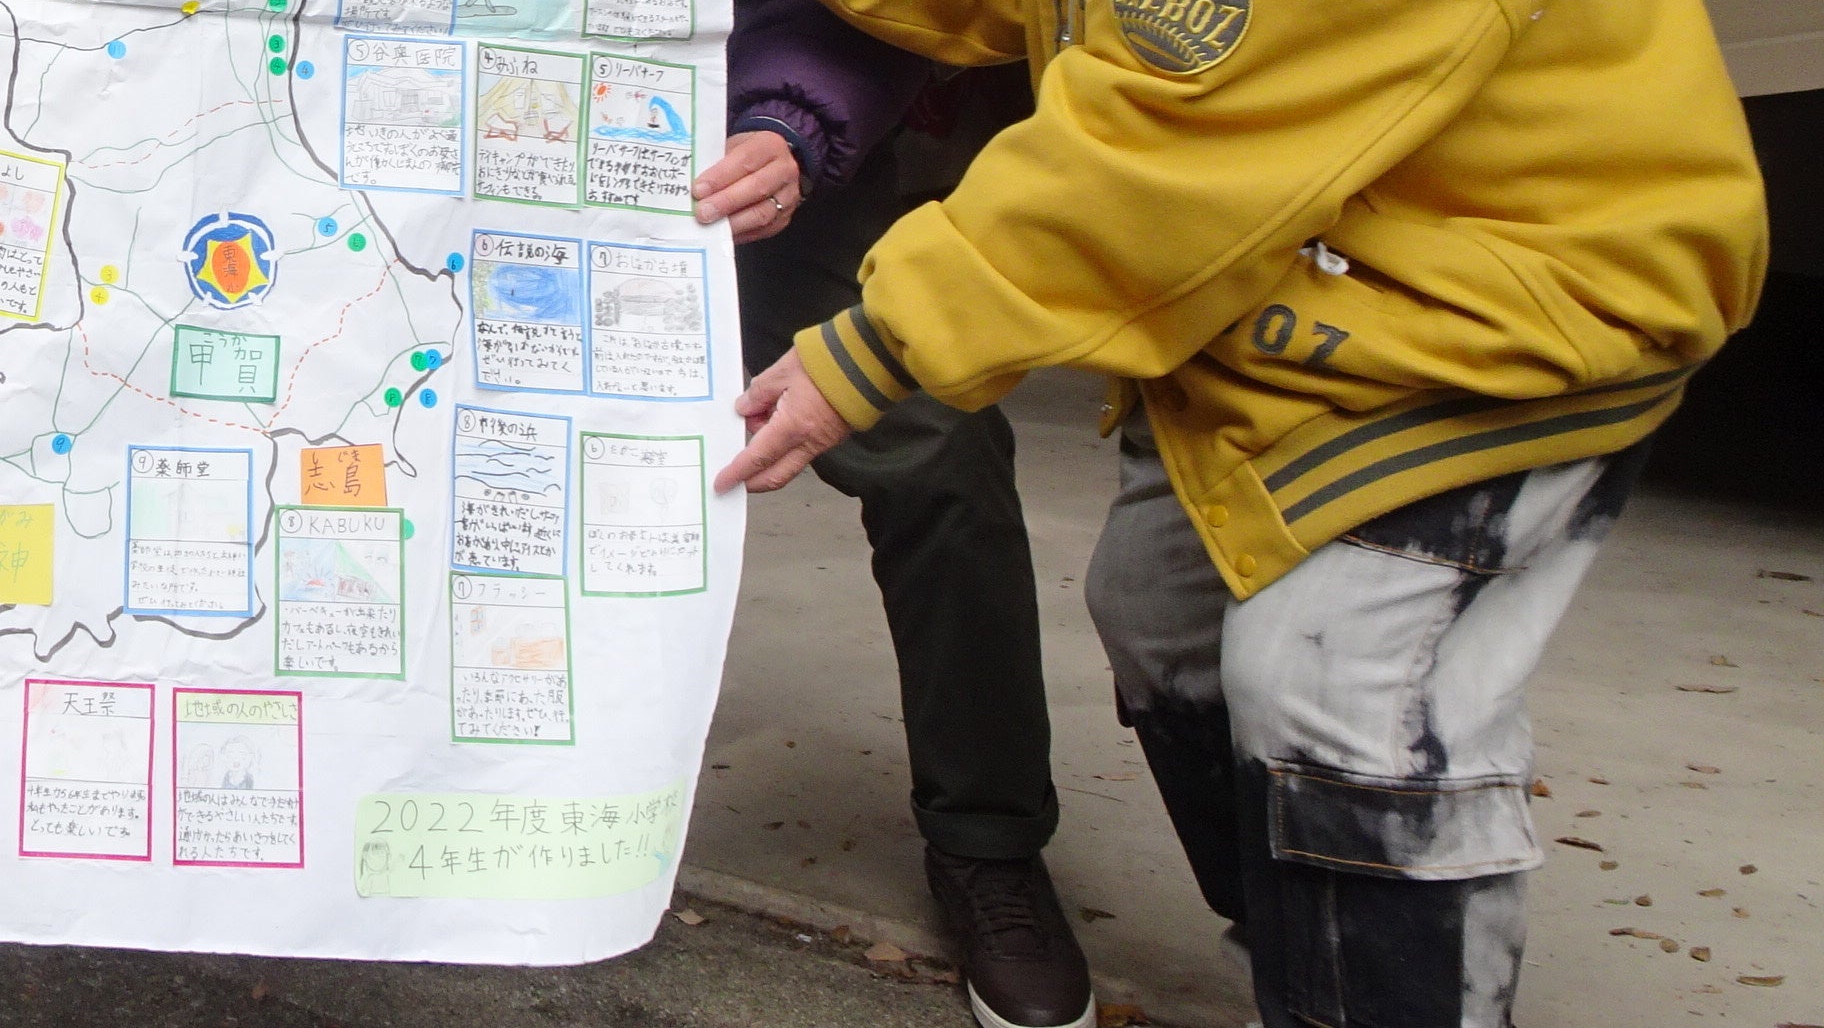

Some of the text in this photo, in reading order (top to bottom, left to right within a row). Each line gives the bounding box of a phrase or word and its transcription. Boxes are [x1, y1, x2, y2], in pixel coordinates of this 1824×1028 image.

[155, 458, 211, 478] 薬師堂
[303, 462, 364, 498] 志島
[61, 691, 116, 717] 天王祭
